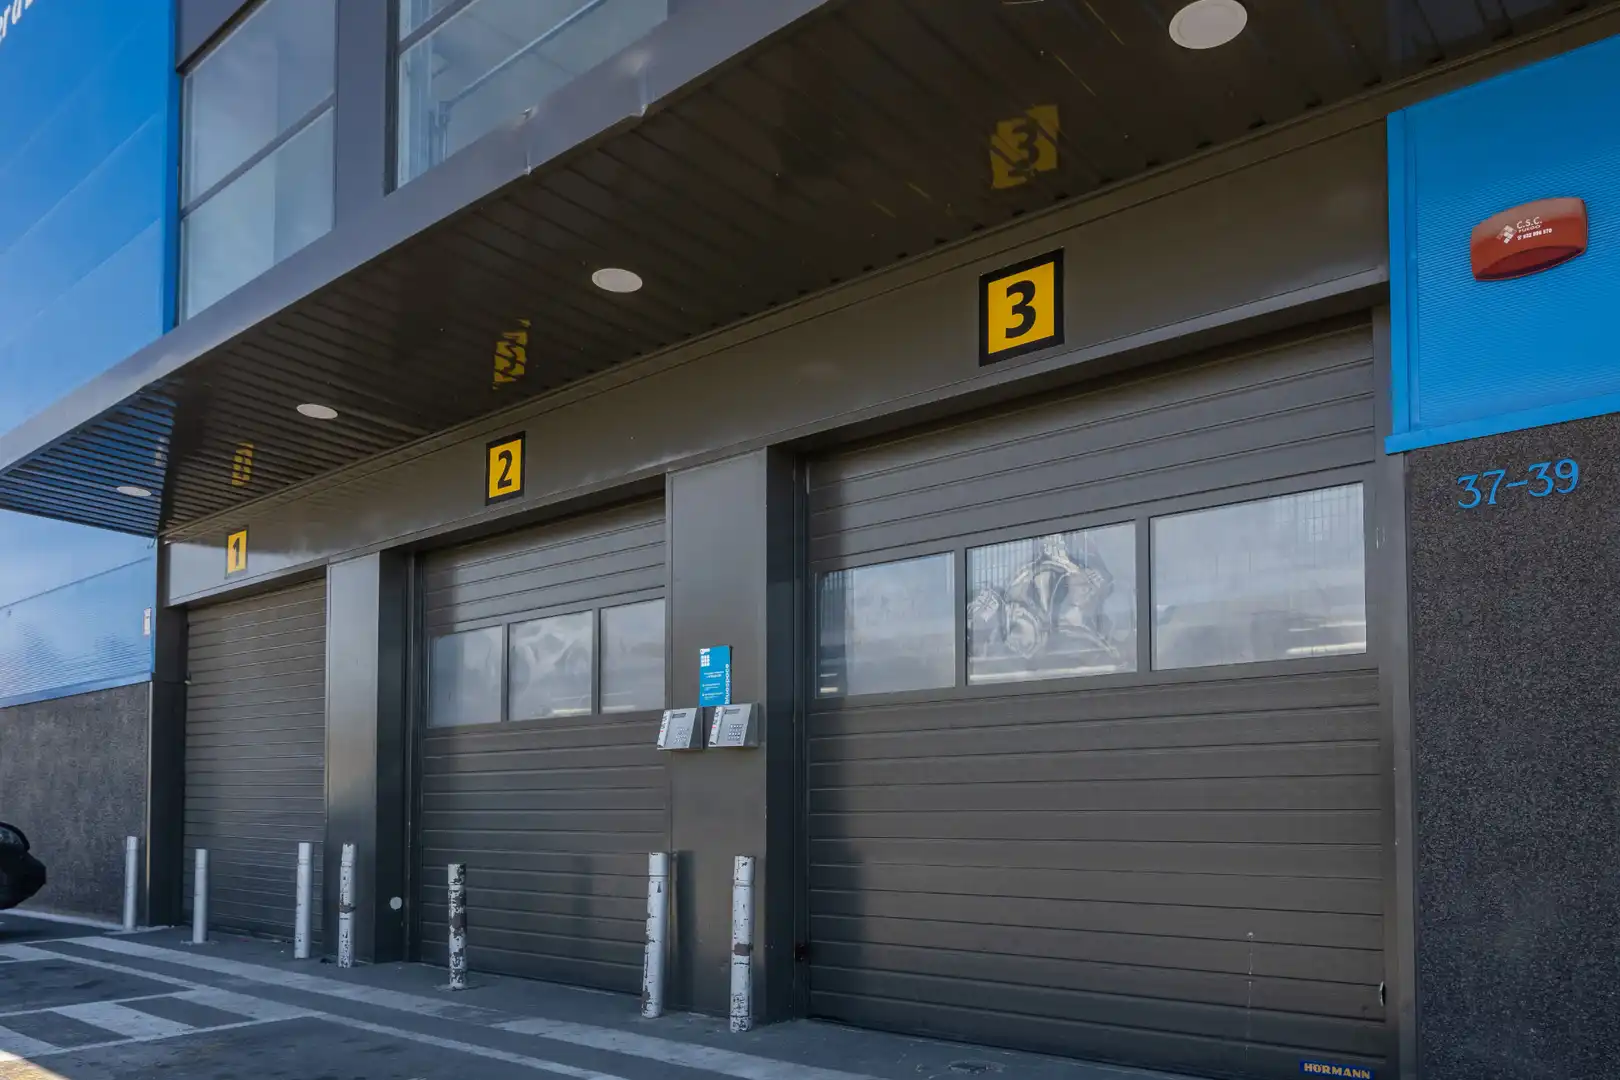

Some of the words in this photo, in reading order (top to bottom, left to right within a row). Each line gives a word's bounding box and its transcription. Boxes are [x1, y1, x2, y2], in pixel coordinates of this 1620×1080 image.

[1516, 216, 1543, 229] C.S.C.
[1005, 280, 1036, 339] 3
[497, 450, 513, 489] 2
[1457, 458, 1579, 509] 37-39
[232, 537, 240, 568] 1
